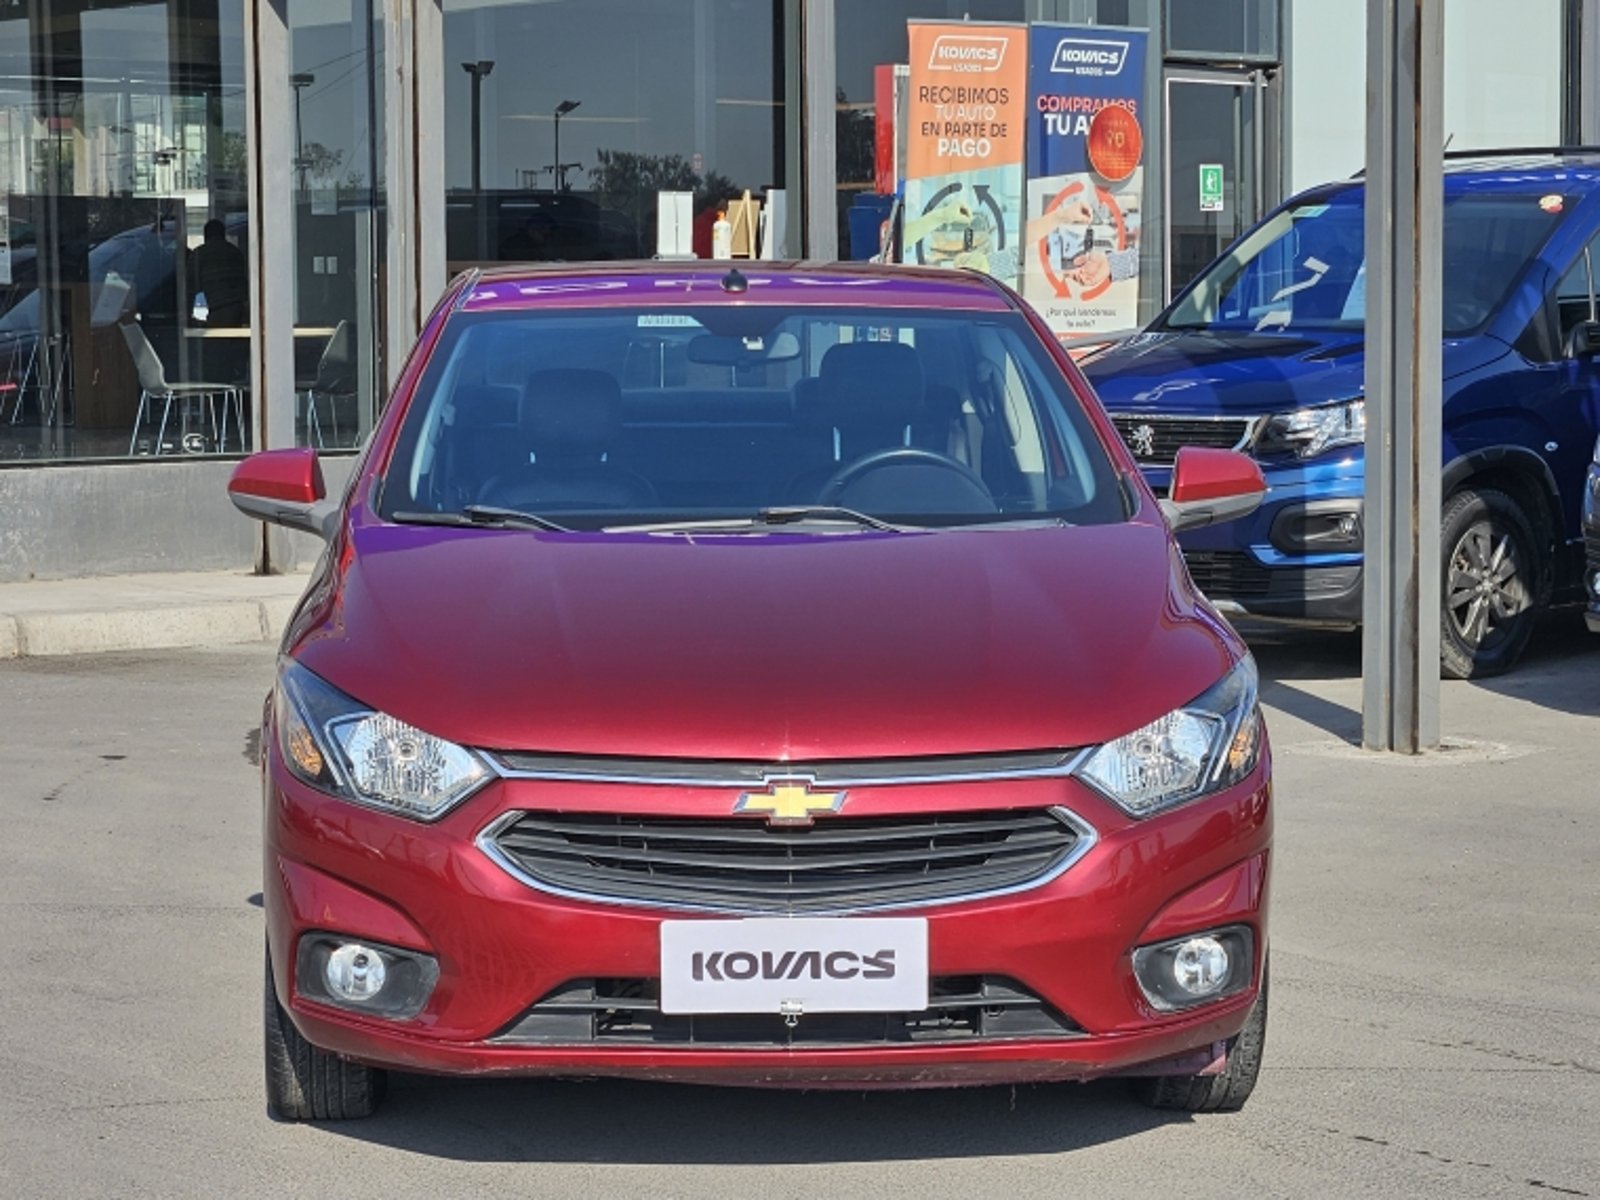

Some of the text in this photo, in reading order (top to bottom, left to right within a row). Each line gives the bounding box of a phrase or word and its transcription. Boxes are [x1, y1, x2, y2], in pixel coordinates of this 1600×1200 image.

[938, 45, 998, 60] KOVACS
[1061, 48, 1119, 65] KOVACS
[919, 85, 1009, 105] RECIBIMOS
[934, 104, 996, 121] TU AUTO
[921, 121, 1007, 138] EN PARTE DE
[1043, 113, 1070, 136] TU
[937, 138, 991, 158] PAGO
[692, 949, 896, 982] KOVACS
